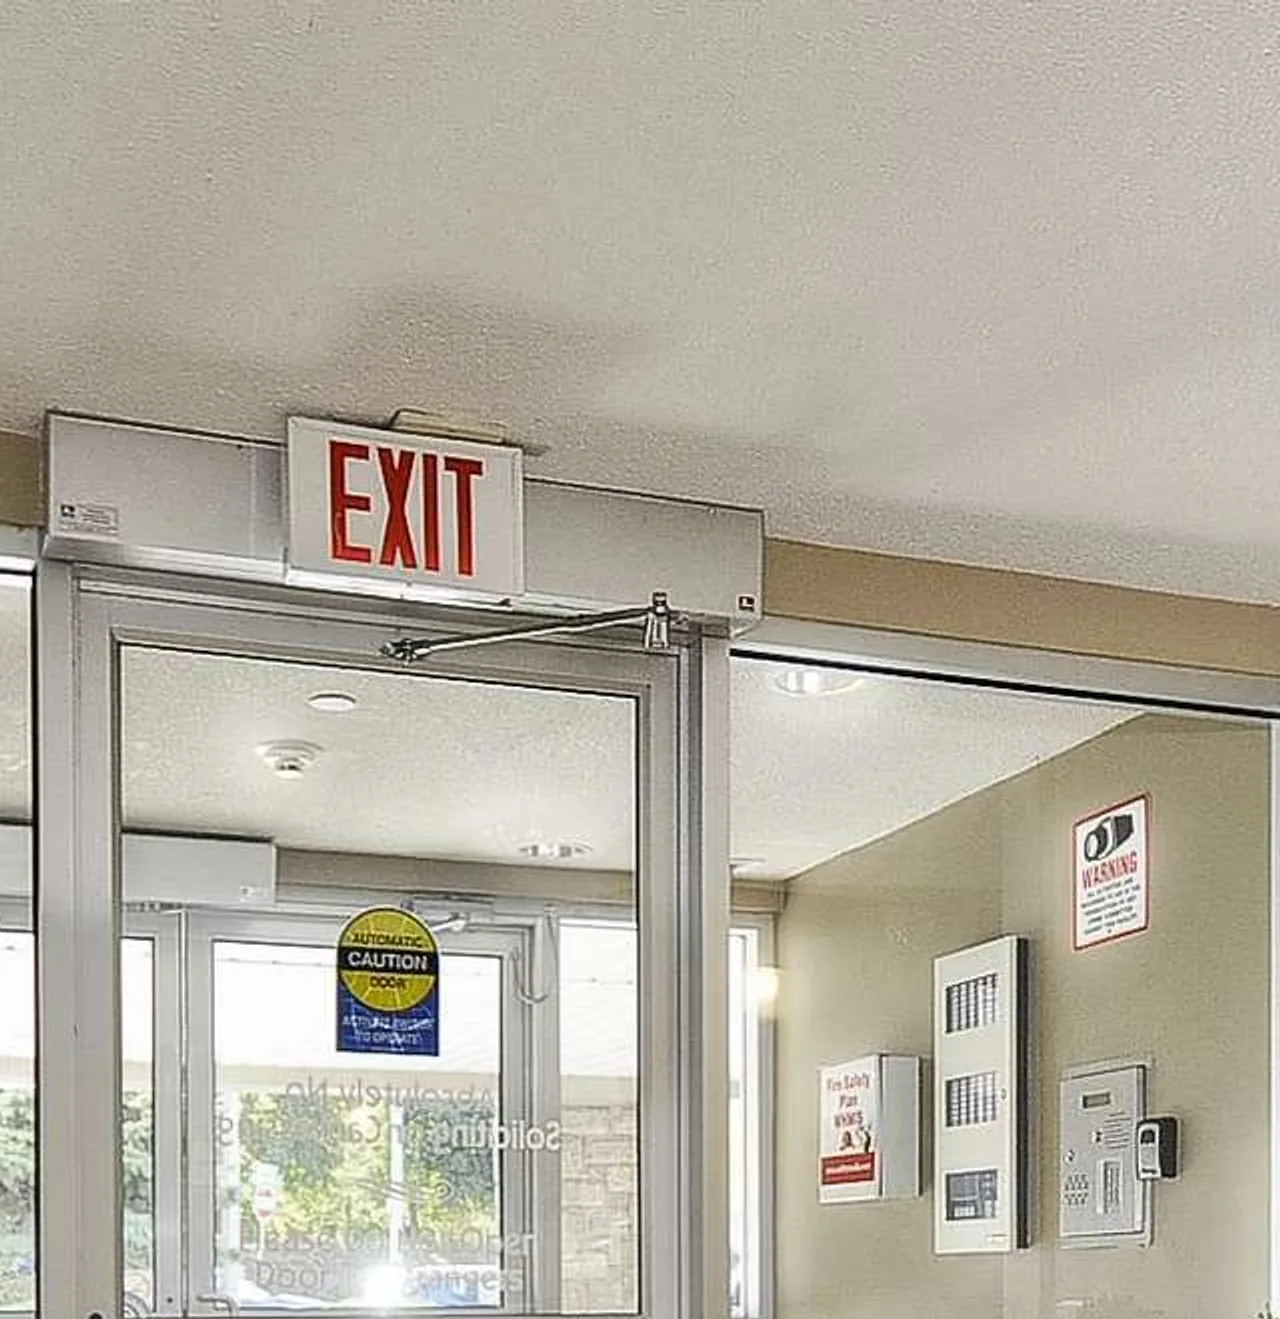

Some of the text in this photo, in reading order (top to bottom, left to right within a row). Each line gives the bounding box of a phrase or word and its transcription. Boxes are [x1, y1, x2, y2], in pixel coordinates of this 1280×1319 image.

[329, 441, 484, 576] EXIT
[1082, 850, 1138, 890] WARNING
[351, 933, 423, 947] AUTOMATIC
[347, 951, 428, 970] CAUTION
[370, 976, 406, 989] DOOR
[257, 1259, 332, 1290] Door
